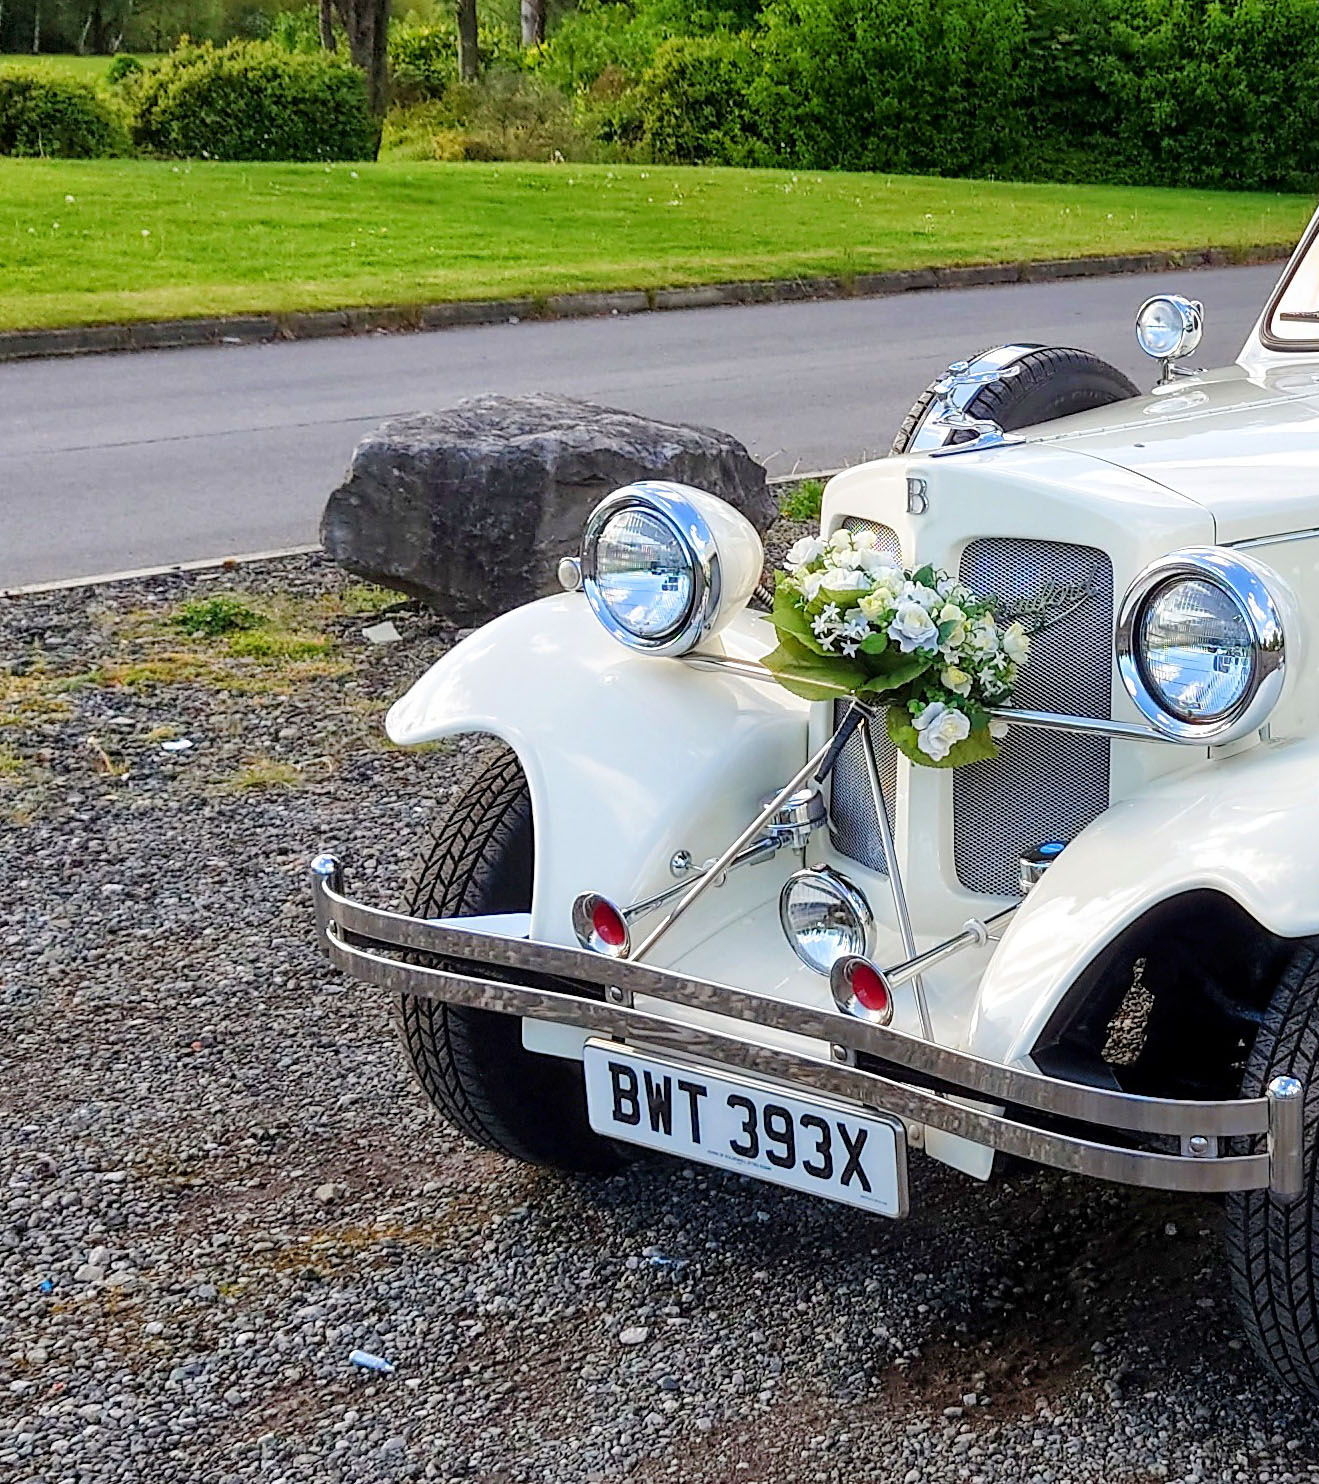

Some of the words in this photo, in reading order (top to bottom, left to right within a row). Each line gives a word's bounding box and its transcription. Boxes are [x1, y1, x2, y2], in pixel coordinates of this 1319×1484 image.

[906, 477, 930, 516] B
[609, 1062, 708, 1144] BWT
[727, 1095, 872, 1192] 393X
